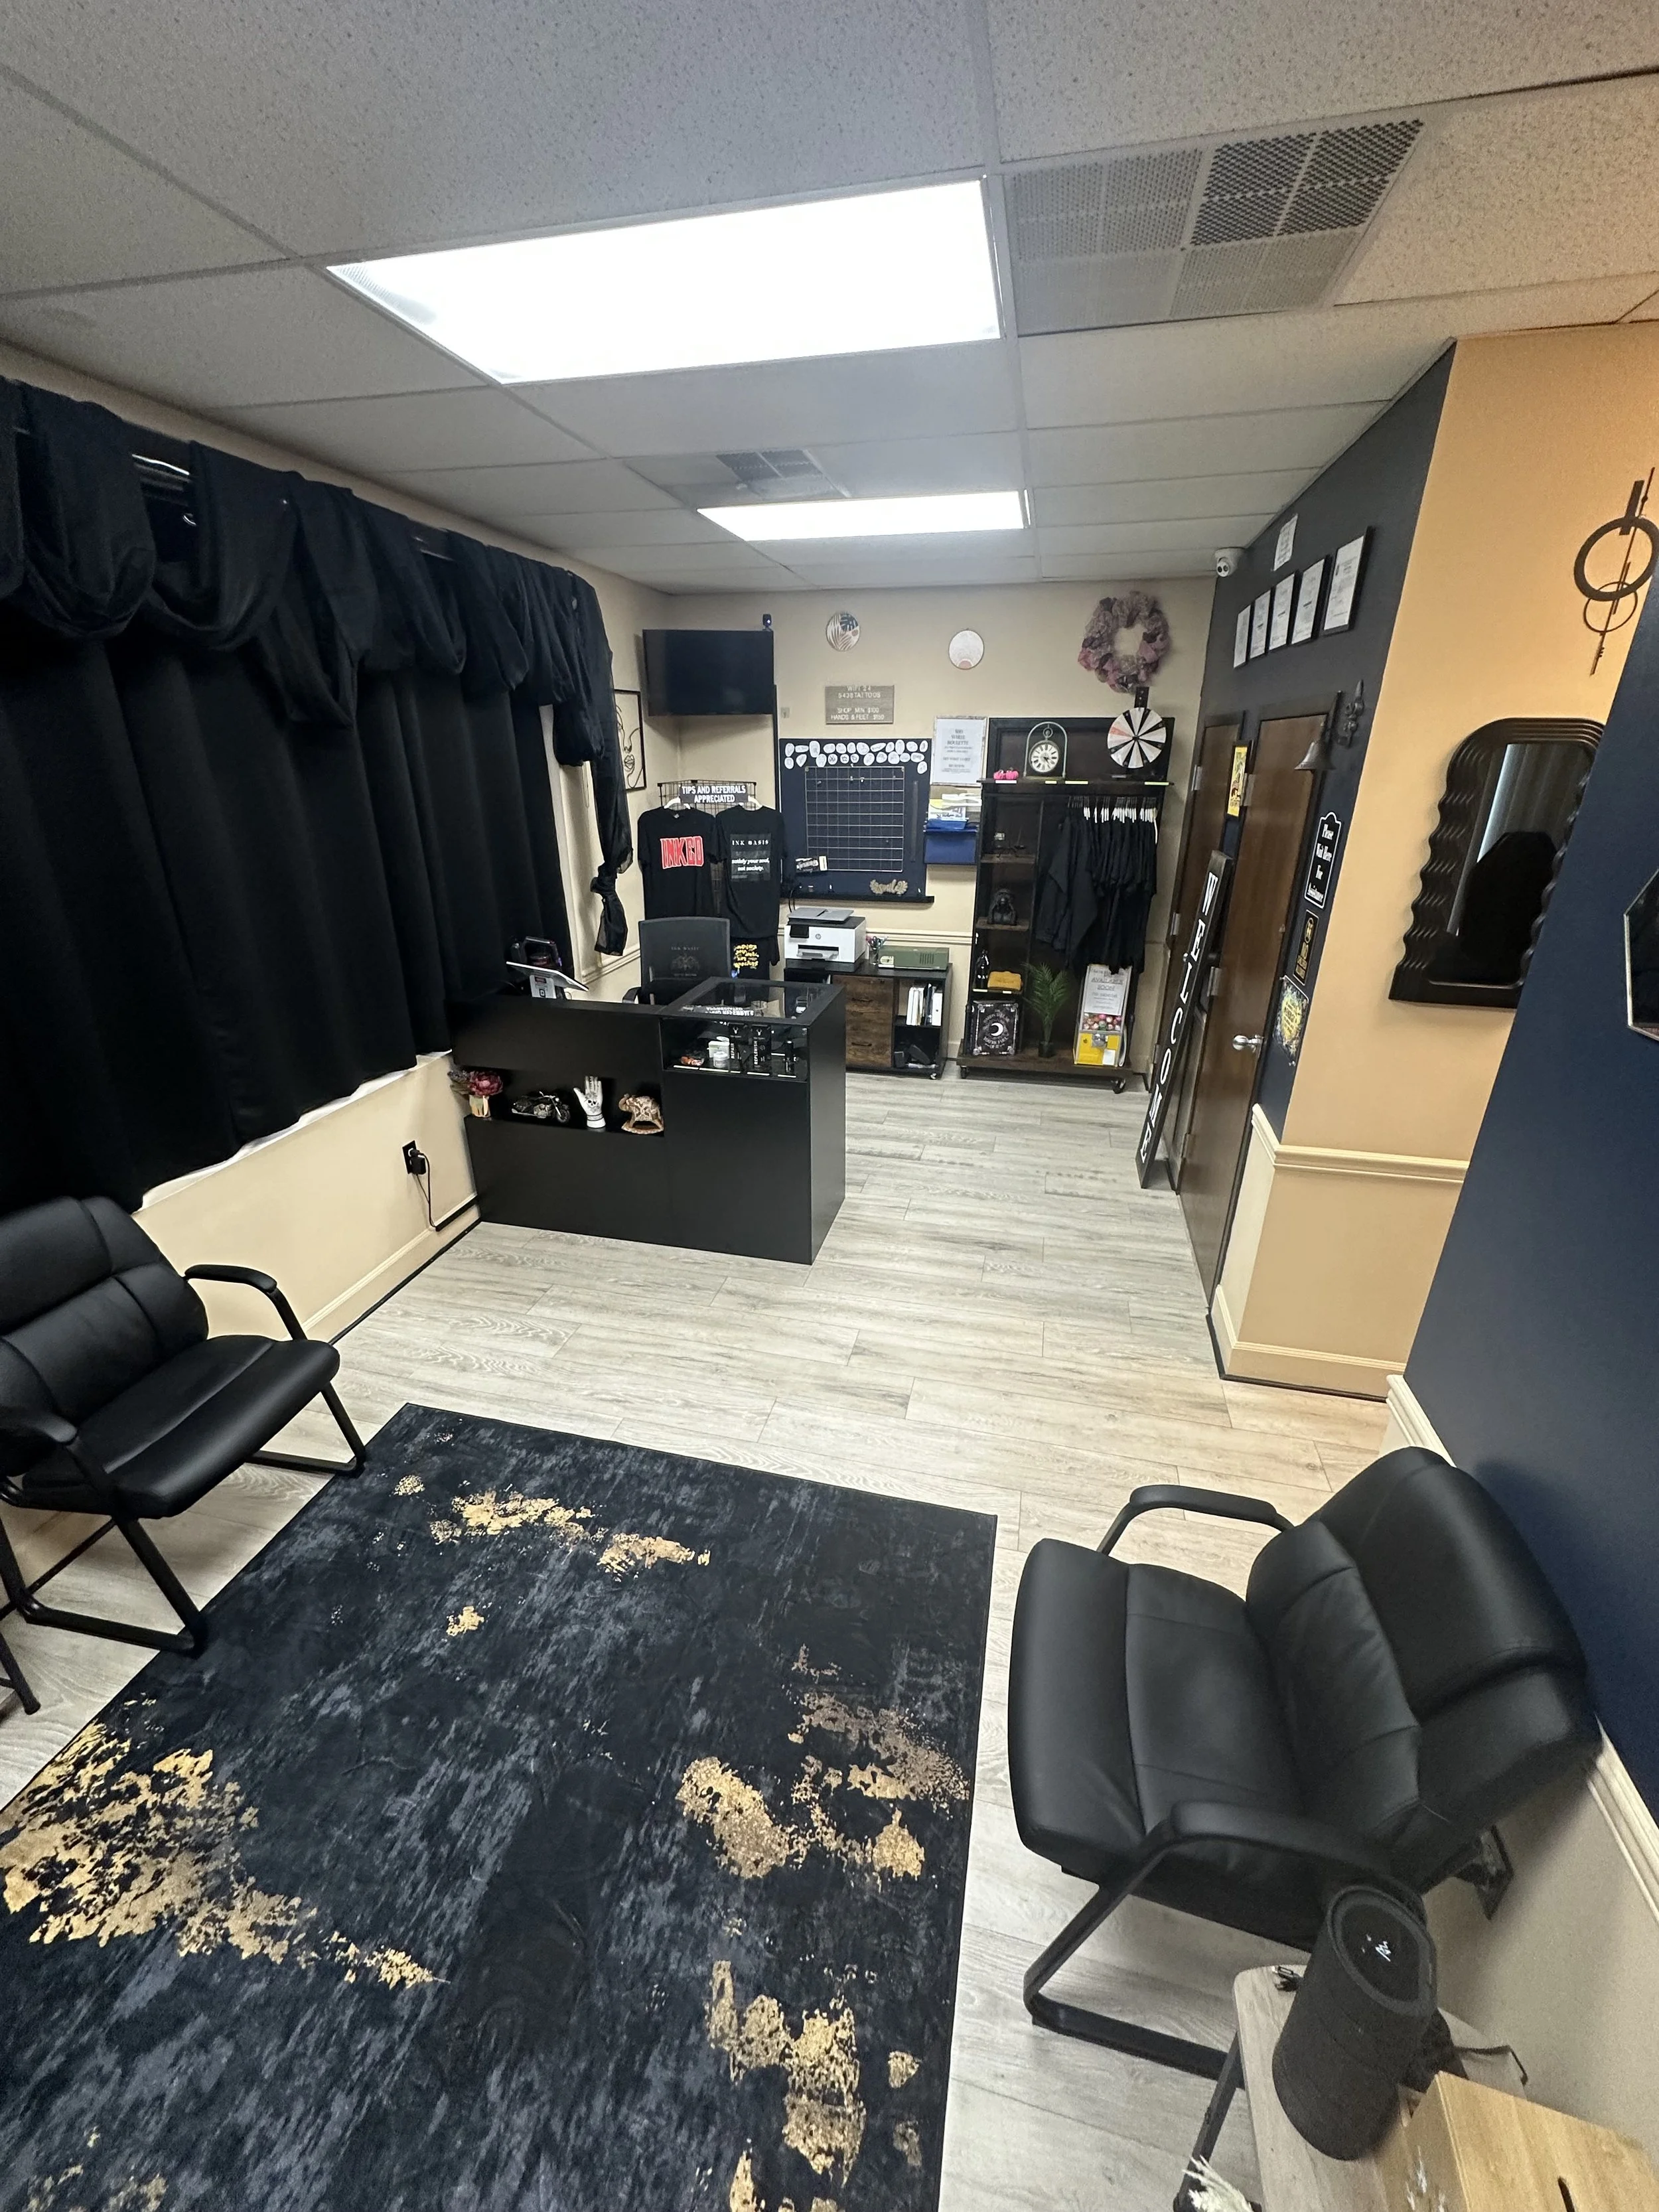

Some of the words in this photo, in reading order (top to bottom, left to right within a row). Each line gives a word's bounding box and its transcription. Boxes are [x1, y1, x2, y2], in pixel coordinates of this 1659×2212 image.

[694, 794, 735, 803] APPRECIATED
[660, 836, 704, 869] INKED
[1140, 871, 1218, 1163] WELCOME
